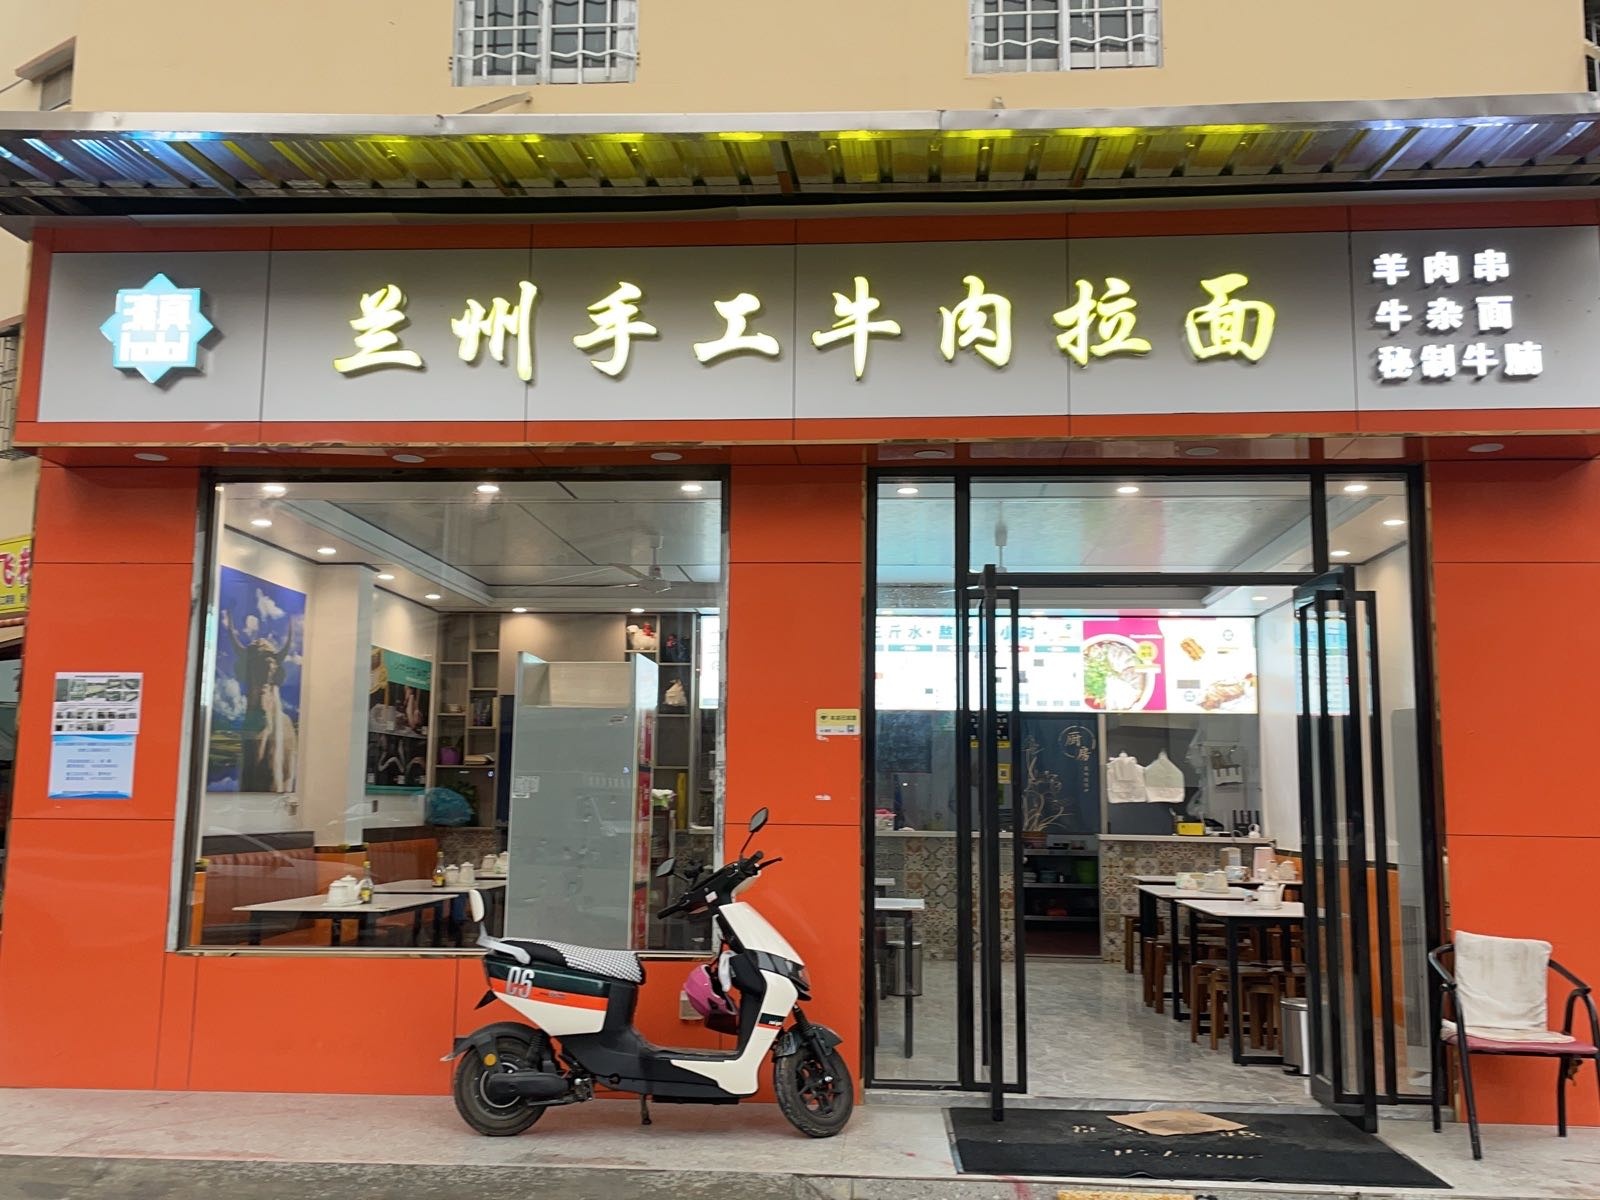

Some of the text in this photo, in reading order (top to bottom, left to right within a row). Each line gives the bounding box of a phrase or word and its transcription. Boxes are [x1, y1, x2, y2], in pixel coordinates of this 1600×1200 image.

[1372, 249, 1510, 285] 羊肉串
[334, 274, 1277, 383] 兰州手工牛肉拉面
[1375, 295, 1513, 332] 牛杂面
[1378, 341, 1543, 379] 秘制牛腩
[506, 966, 535, 999] 06
